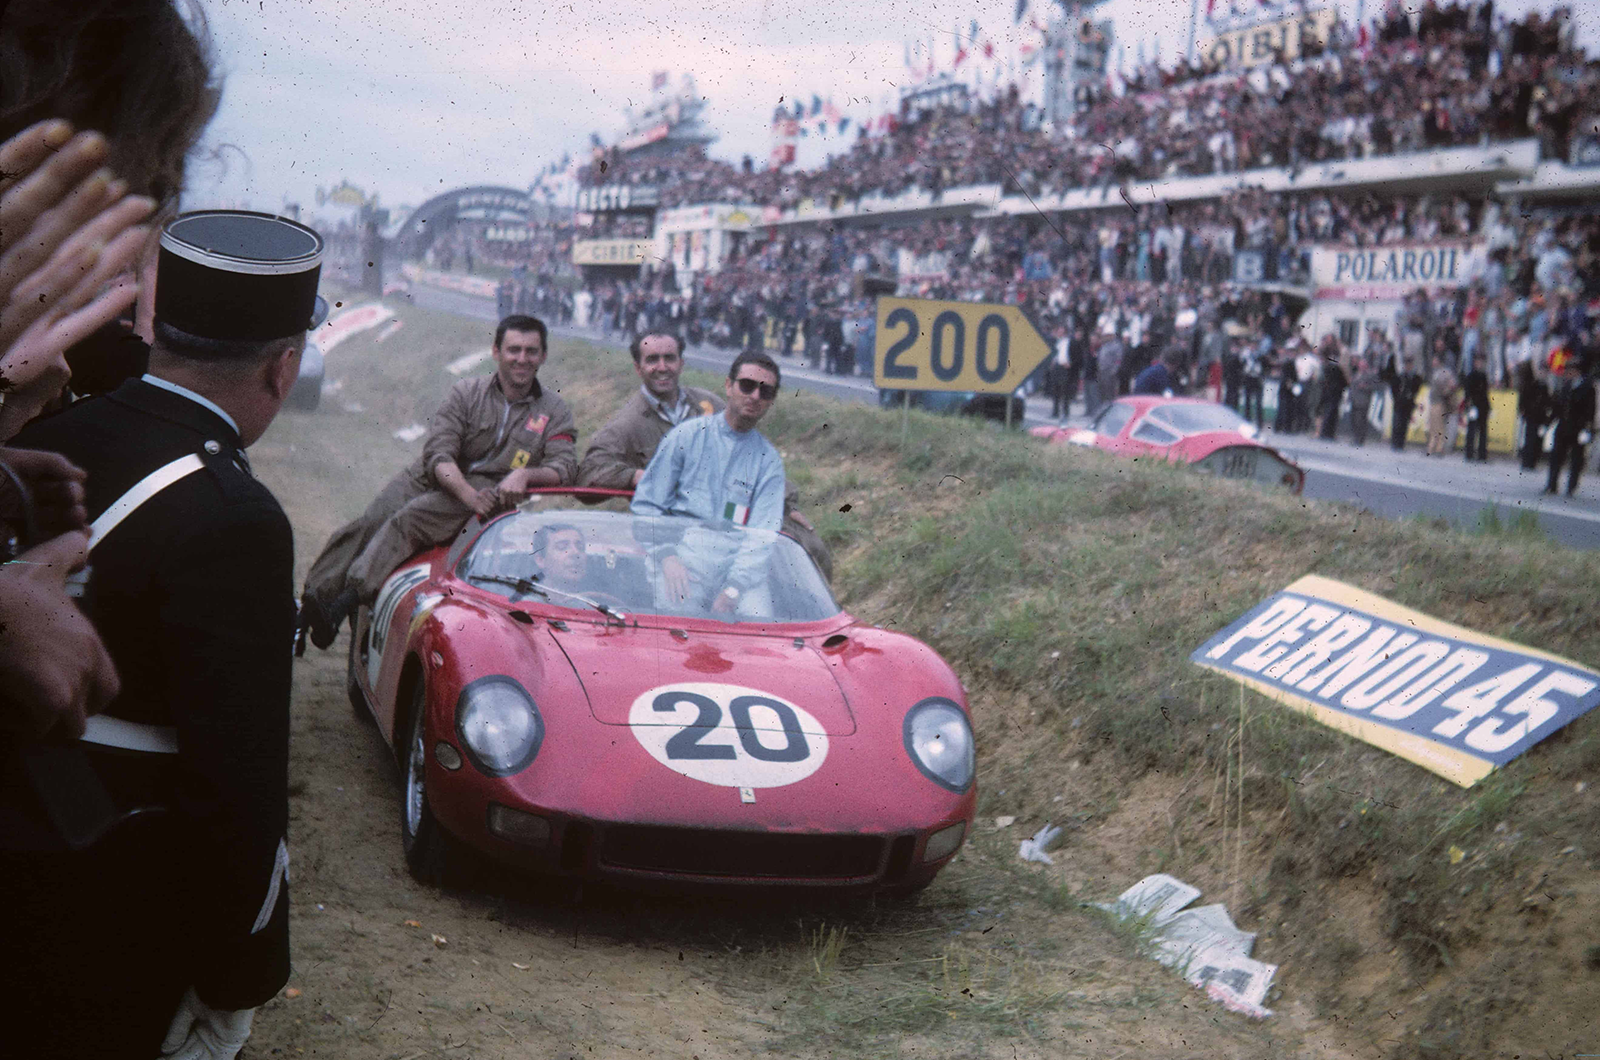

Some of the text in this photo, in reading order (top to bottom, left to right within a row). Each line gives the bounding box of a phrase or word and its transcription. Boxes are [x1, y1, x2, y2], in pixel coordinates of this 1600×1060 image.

[883, 307, 1010, 384] 200
[1205, 595, 1598, 753] PERNOD 45
[651, 690, 811, 763] 20
